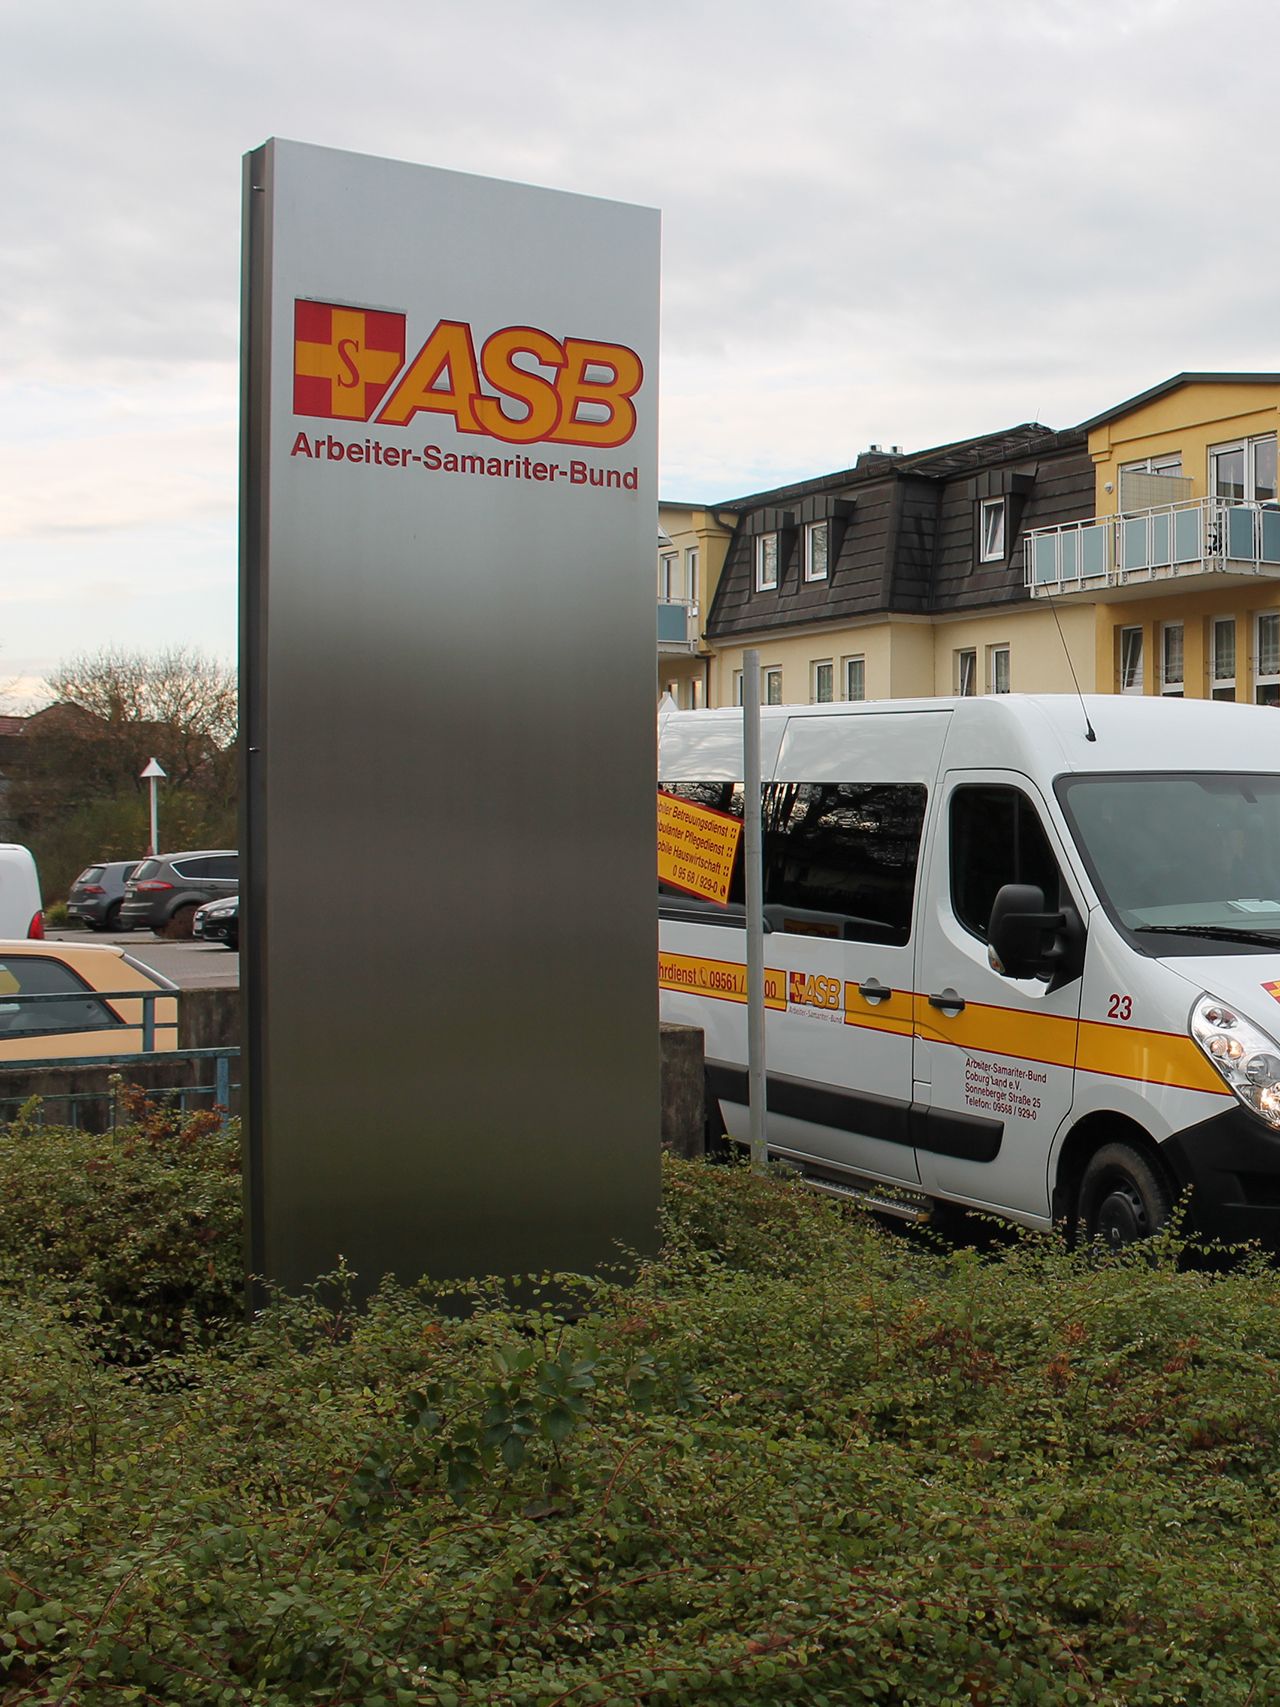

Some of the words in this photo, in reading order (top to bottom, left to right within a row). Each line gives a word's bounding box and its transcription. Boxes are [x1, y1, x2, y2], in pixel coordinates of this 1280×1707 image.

[374, 319, 644, 448] ASB
[291, 432, 638, 490] Arbeiter-Samariter-Bund
[672, 806, 729, 838] Betreuungsdienst
[658, 821, 684, 840] bulanter
[684, 830, 724, 856] Pflegedienst
[673, 846, 721, 875] Hauswirtschaft
[700, 875, 718, 894] 929-0
[658, 961, 697, 985] hrdienst
[709, 971, 737, 992] 09561
[801, 975, 841, 1010] ASB
[1107, 993, 1133, 1021] 23
[965, 1058, 1047, 1083] Arbeiter-Samariter-Bund
[965, 1070, 990, 1087] Coburg
[991, 1075, 1008, 1088] Land
[1008, 1080, 1022, 1091] e.V.
[965, 1083, 1007, 1101] Sonneberger
[1008, 1092, 1031, 1106] Straße
[1032, 1097, 1041, 1108] 25
[965, 1095, 992, 1110] Telefon:
[1018, 1107, 1037, 1121] 929-0
